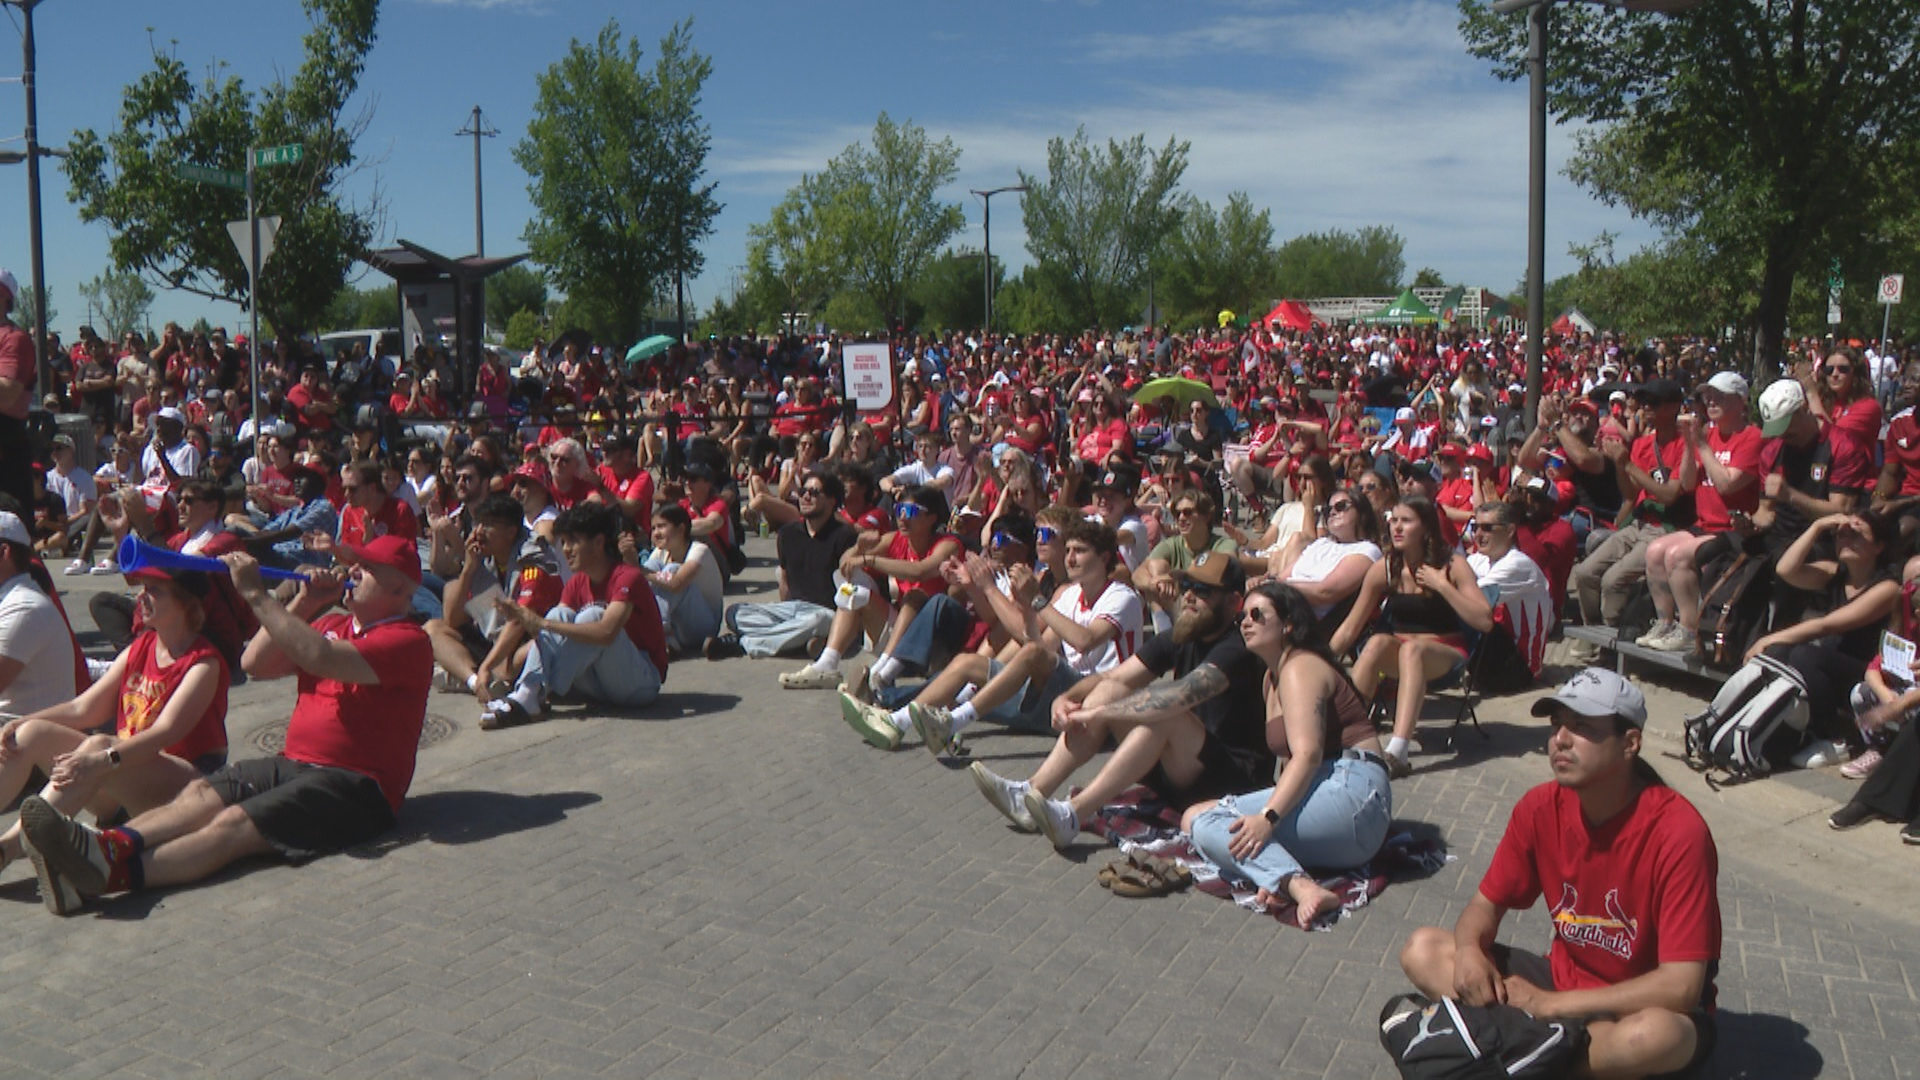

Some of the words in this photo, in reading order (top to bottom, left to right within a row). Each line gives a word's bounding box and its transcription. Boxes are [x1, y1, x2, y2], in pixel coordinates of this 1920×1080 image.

[262, 149, 277, 162] AVE
[282, 147, 288, 160] A
[292, 147, 298, 159] S
